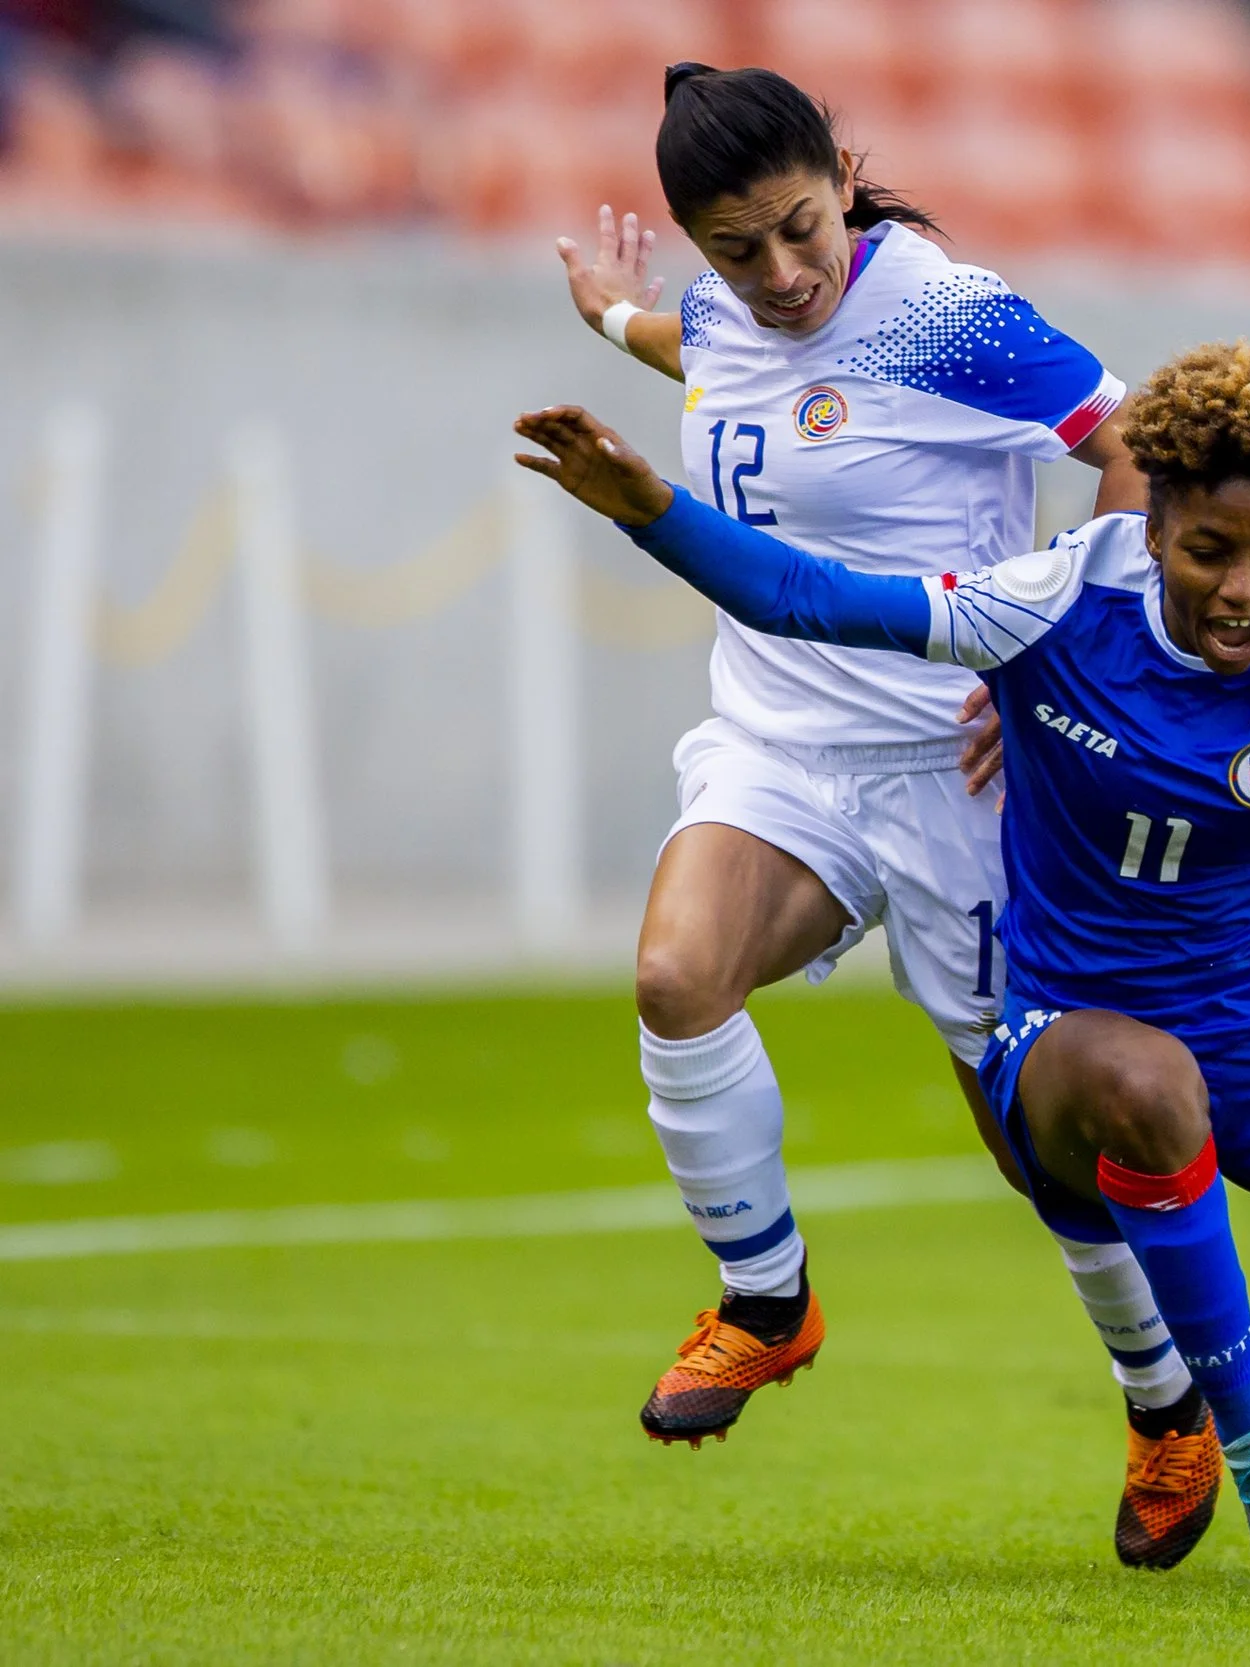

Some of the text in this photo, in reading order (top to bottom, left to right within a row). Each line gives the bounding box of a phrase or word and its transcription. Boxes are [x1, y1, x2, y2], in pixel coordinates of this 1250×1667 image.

[708, 419, 779, 526] 12
[1033, 703, 1118, 759] SAETA
[1119, 811, 1193, 882] 11
[705, 1200, 753, 1218] RICA
